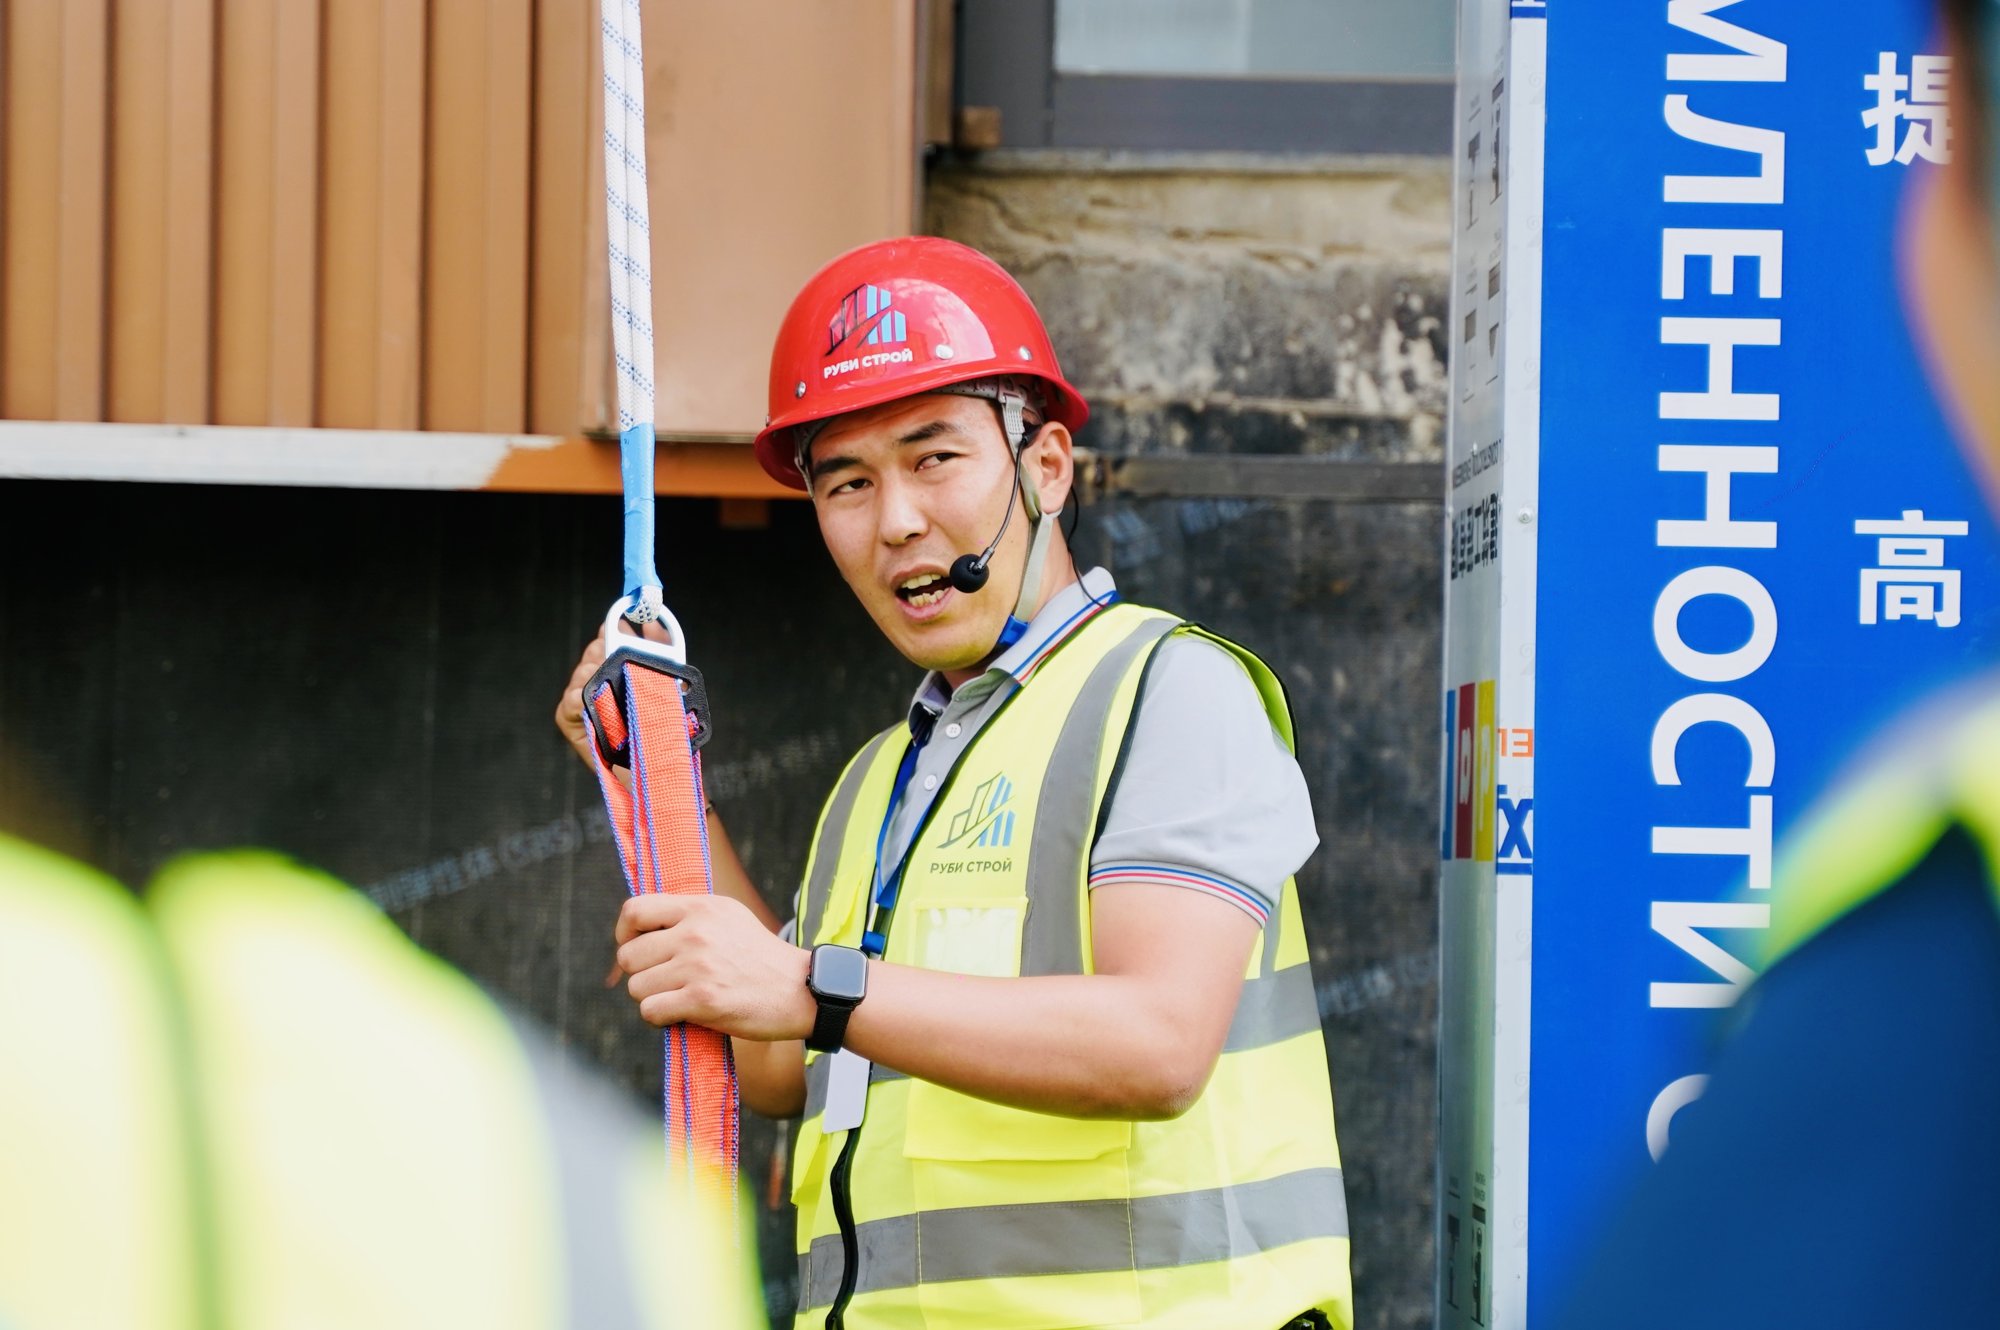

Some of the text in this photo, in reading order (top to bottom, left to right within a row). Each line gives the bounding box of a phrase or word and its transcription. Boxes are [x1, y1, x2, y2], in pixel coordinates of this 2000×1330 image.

[823, 348, 913, 379] РУБИ СТРОЙ
[930, 857, 1012, 874] РУБИ СТРОЙ
